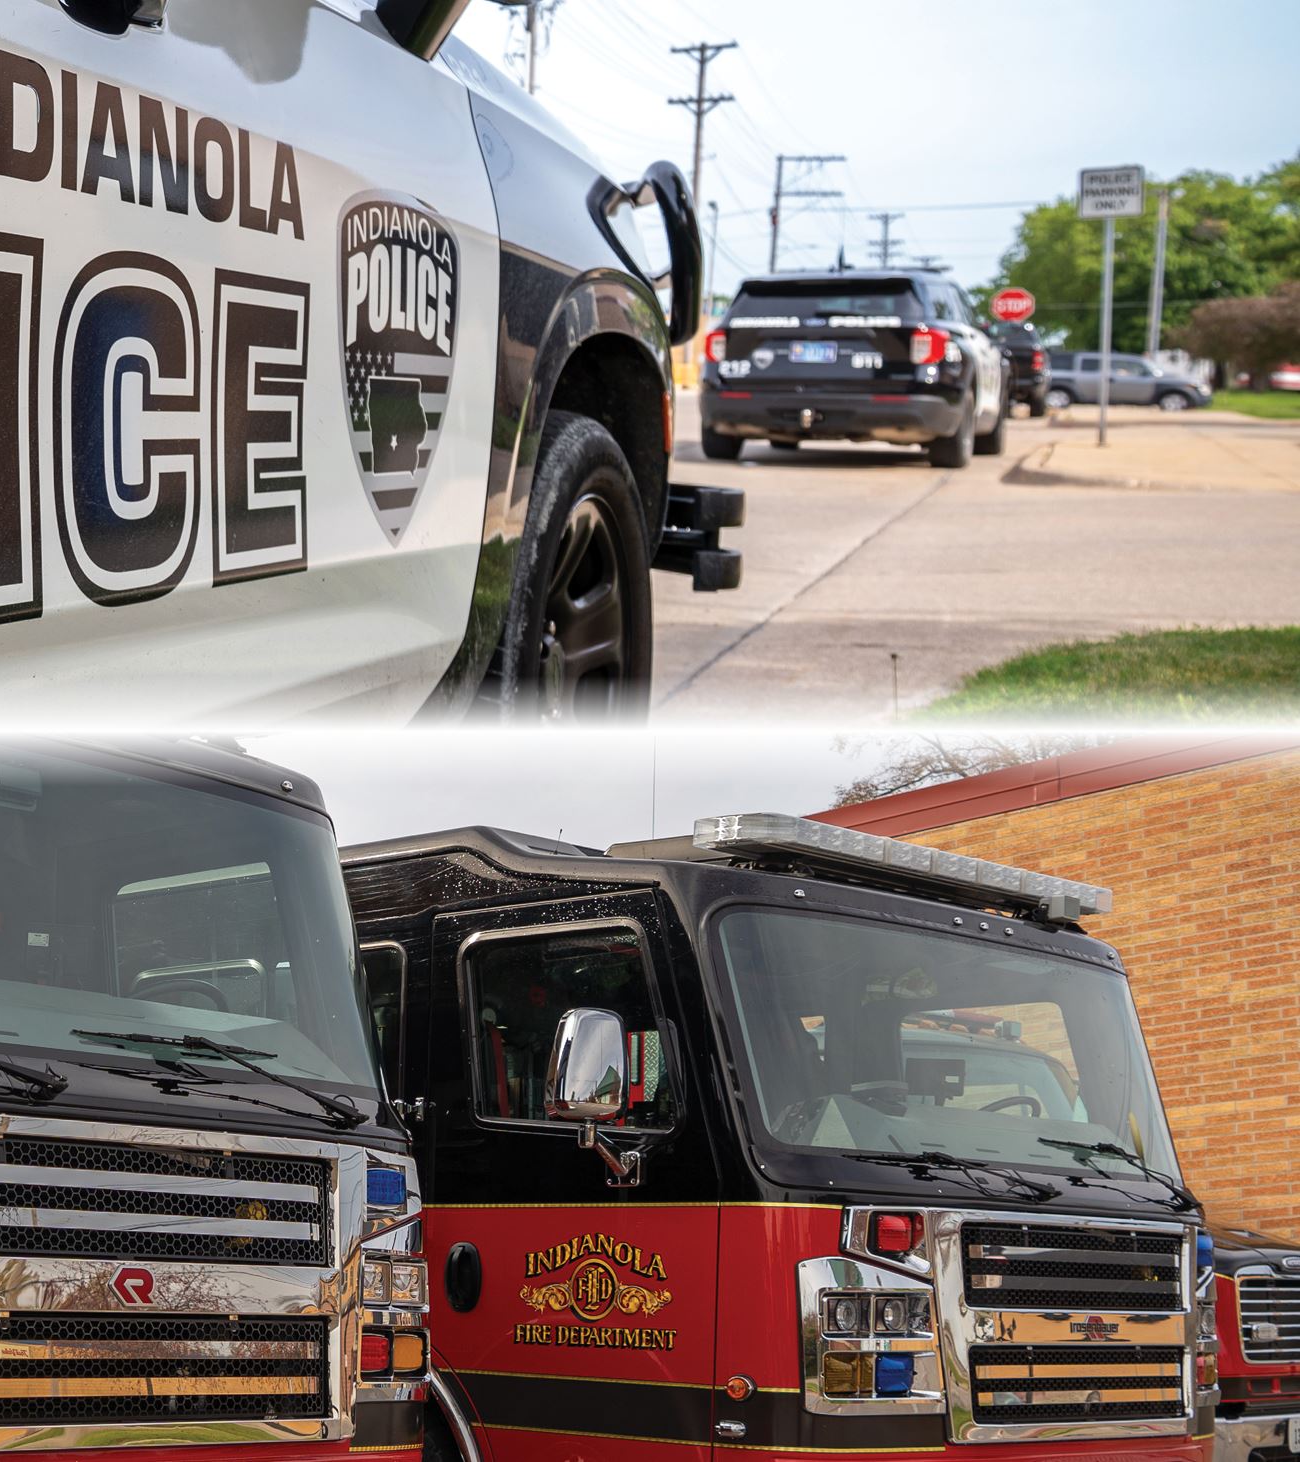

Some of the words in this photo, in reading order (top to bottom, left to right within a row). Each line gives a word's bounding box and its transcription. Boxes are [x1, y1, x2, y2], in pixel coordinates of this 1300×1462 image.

[1087, 173, 1133, 185] POLICE
[1083, 186, 1140, 198] PARKING
[1094, 199, 1128, 211] ONLY
[347, 205, 454, 275] INDIANOLA
[345, 243, 452, 358] POLICE
[995, 298, 1029, 313] STOP
[525, 1232, 668, 1281] INDIANOLA
[514, 1323, 552, 1345] FIRE
[556, 1325, 677, 1351] DEPARTMENT
